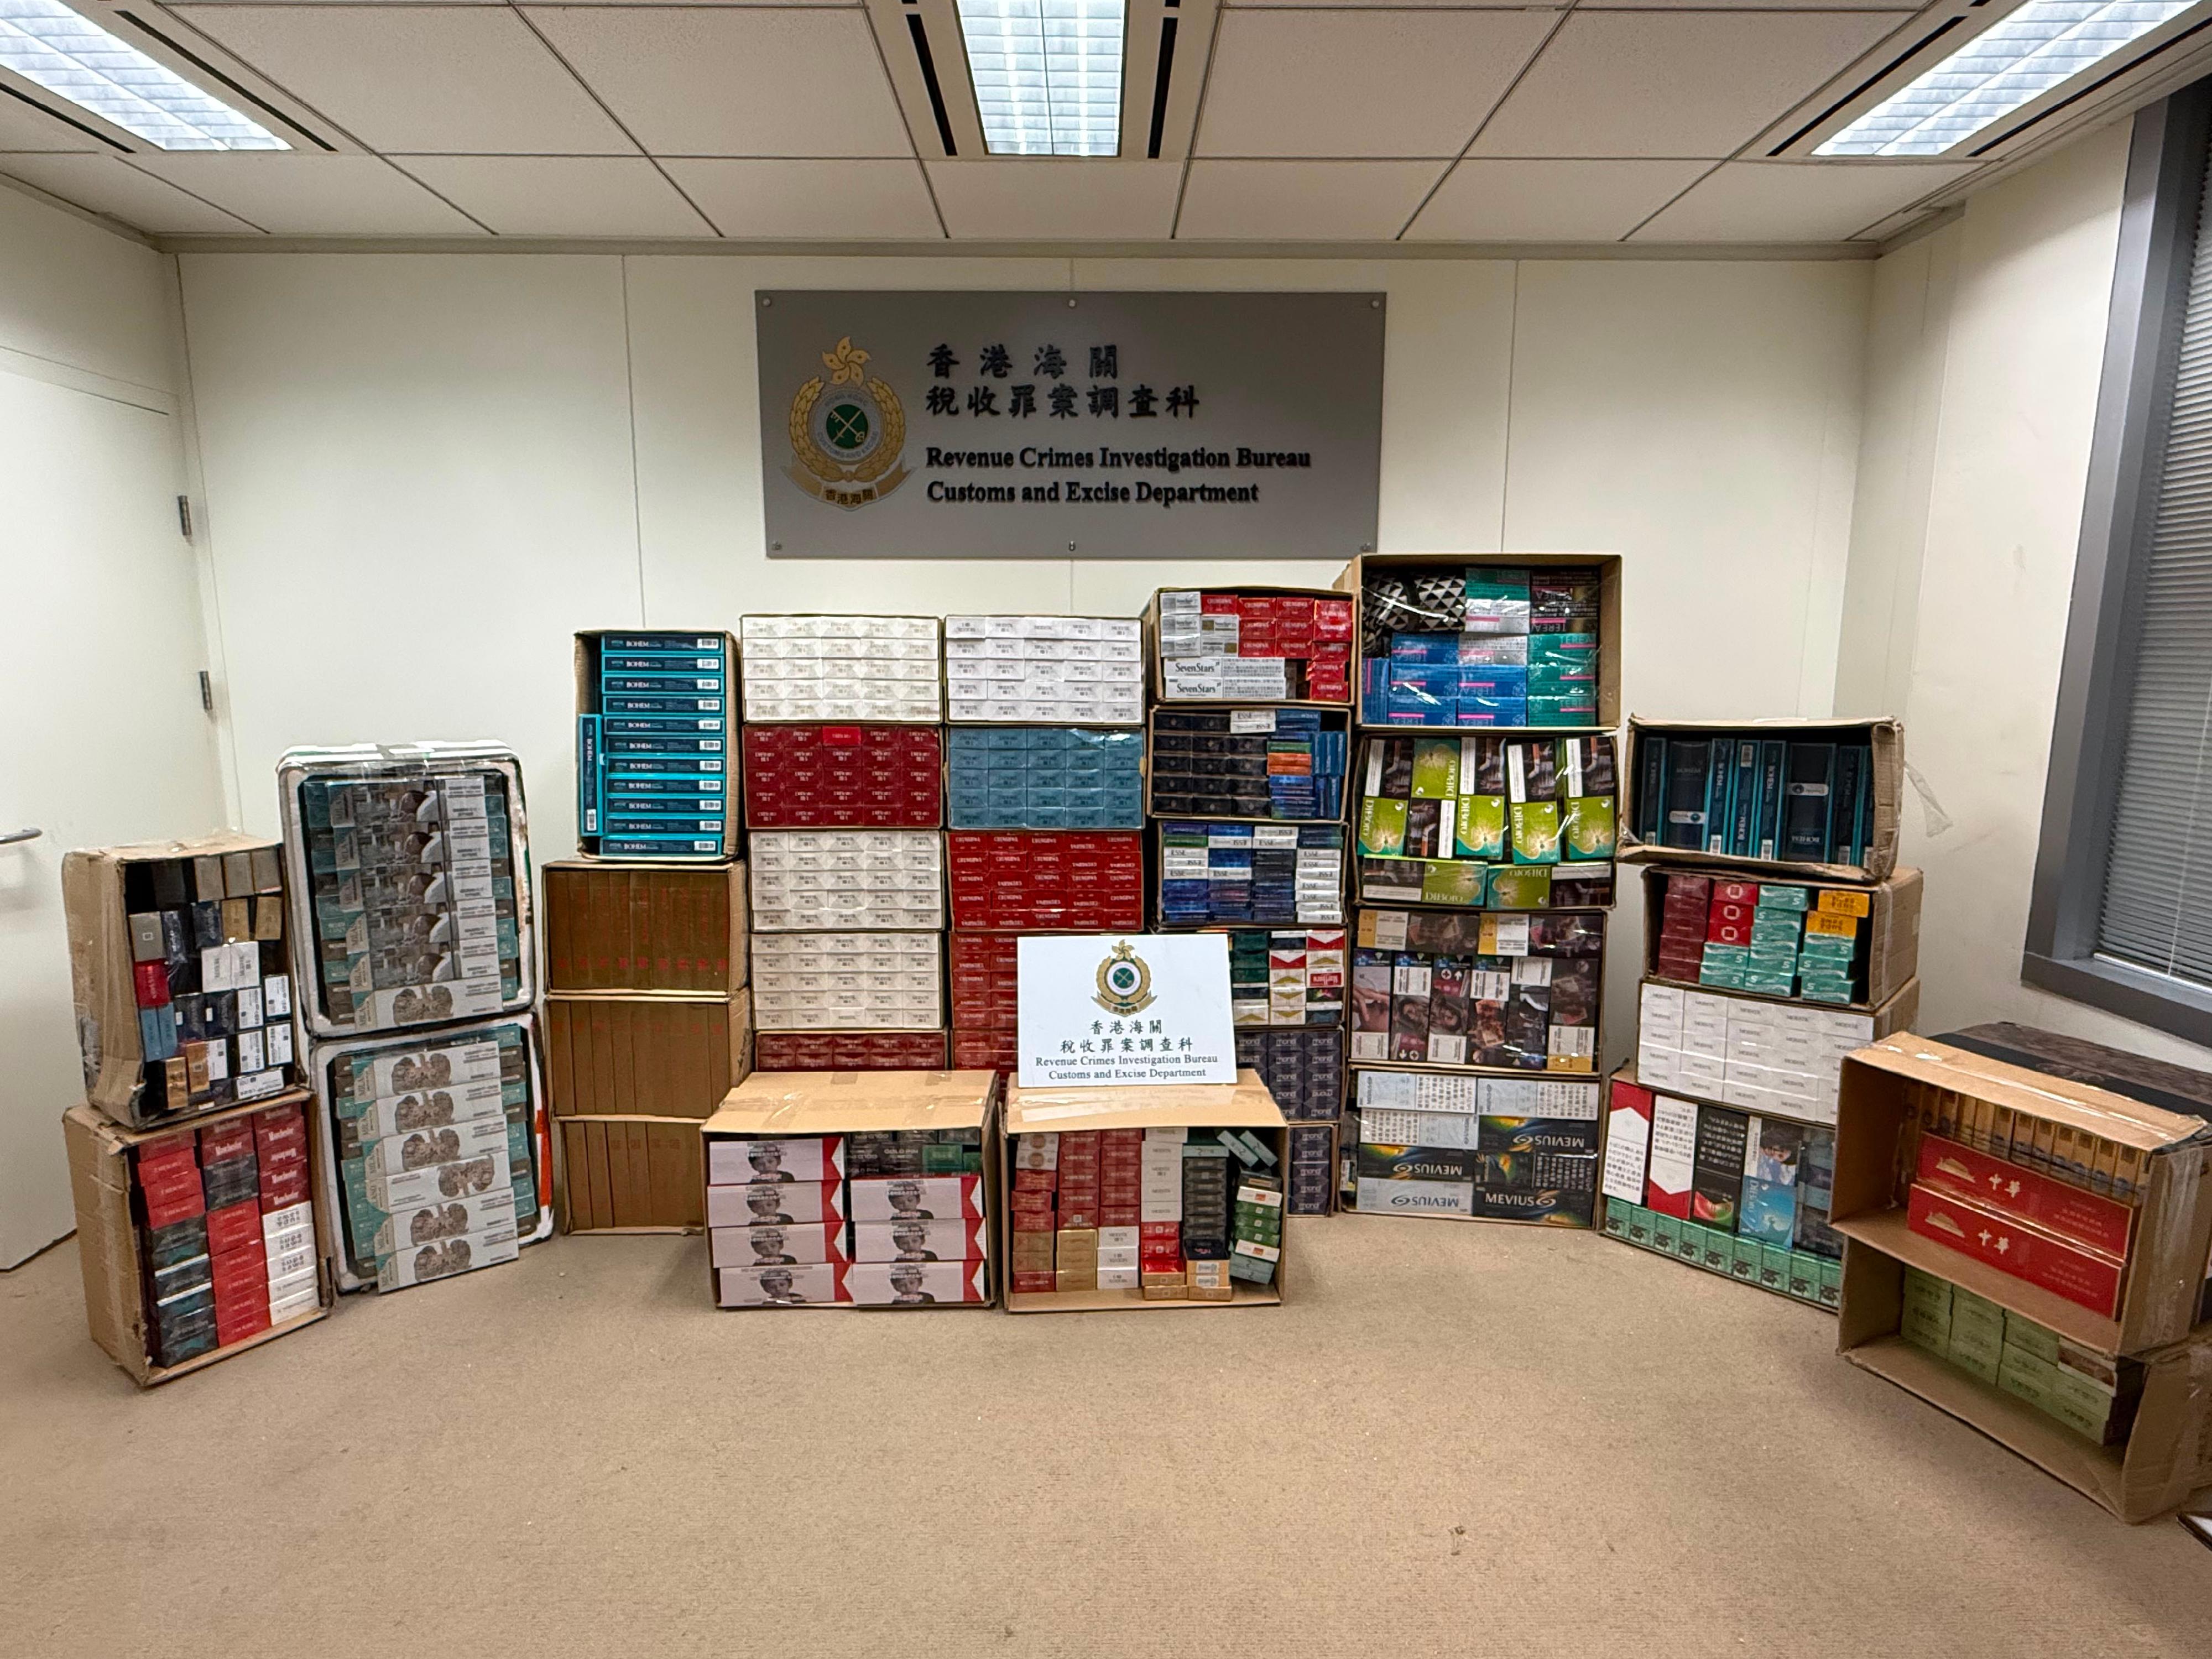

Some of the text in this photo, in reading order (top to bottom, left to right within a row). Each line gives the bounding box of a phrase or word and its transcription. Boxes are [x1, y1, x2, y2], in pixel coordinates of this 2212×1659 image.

[926, 343, 1118, 379] 香港海關
[926, 384, 1199, 419] 稅收罪案調查科
[926, 446, 1311, 471] Revenue Crimes Investigation Bureau
[927, 481, 1259, 507] Customs and Excise Department
[1175, 663, 1214, 672] SevenStars
[1177, 684, 1215, 693] SevenStars
[1090, 1019, 1163, 1035] 香港海關
[1060, 1037, 1193, 1054] 稅收罪案調查科
[1036, 1055, 1218, 1067] Revenue Crimes Investigation Bureau
[1048, 1069, 1206, 1080] Customs and Excise Department
[1534, 1135, 1584, 1147] MEVIUS
[1415, 1165, 1463, 1176] MEVIUS
[1412, 1197, 1459, 1207] MEVIUS
[1485, 1193, 1535, 1207] MEVIUS
